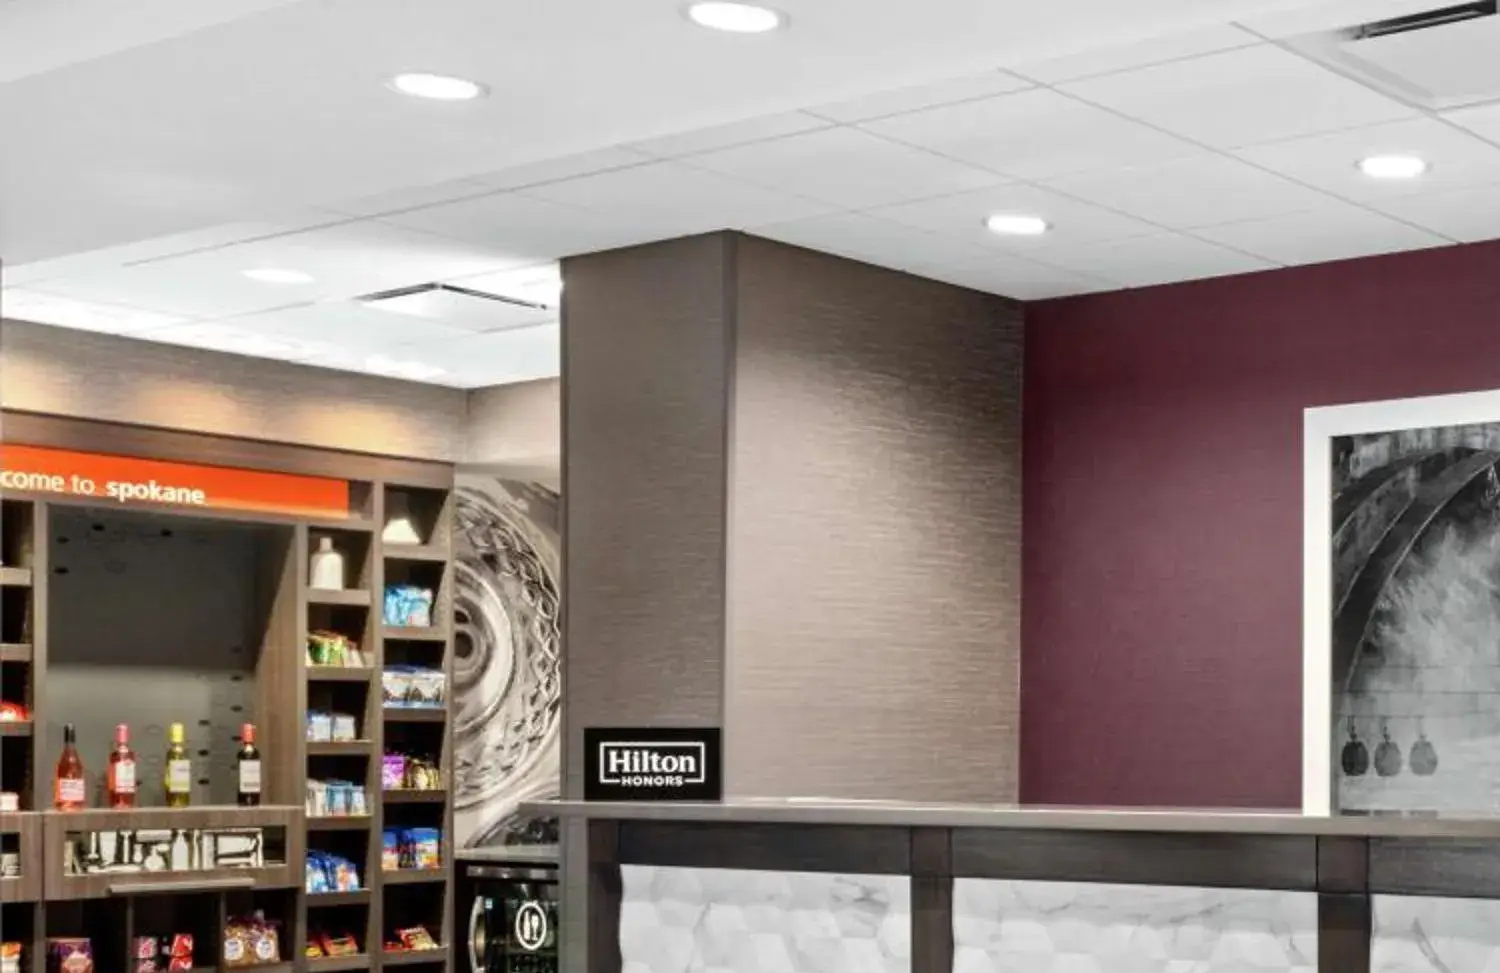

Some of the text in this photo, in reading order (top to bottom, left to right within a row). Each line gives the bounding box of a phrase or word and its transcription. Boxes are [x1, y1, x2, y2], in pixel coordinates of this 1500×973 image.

[71, 474, 96, 495] to
[106, 480, 206, 504] spokane
[609, 750, 697, 773] Hilton
[621, 776, 683, 787] HONORS
